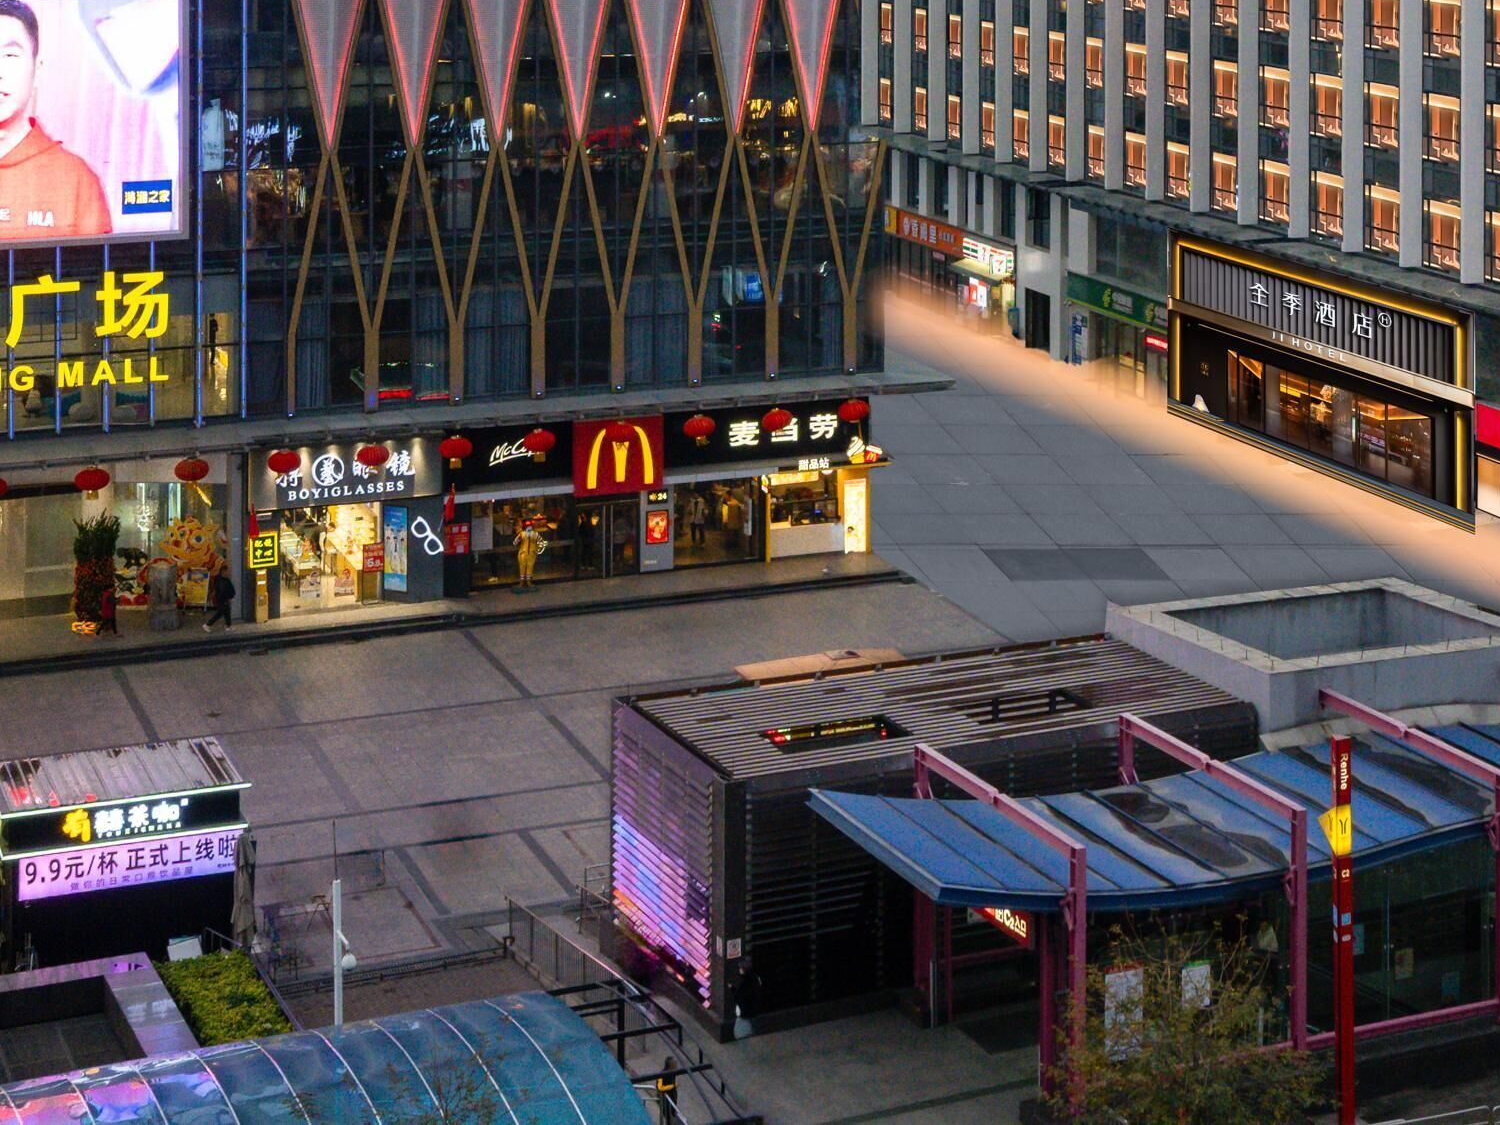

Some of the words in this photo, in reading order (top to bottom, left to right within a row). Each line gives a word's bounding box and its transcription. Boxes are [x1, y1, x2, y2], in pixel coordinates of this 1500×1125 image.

[27, 210, 55, 227] HLA
[5, 270, 170, 349] 广场
[1249, 282, 1373, 339] 全季酒店
[1271, 331, 1284, 342] JI
[1292, 337, 1347, 363] HOTEL
[57, 356, 170, 388] MALL
[728, 413, 838, 448] 麦当劳
[798, 457, 830, 472] 甜品站
[287, 480, 405, 502] BOYIGLASSES
[657, 491, 668, 501] 24
[1340, 753, 1349, 791] Renhe
[25, 851, 119, 885] 9.9元/杯
[125, 834, 236, 873] 正式上线啦
